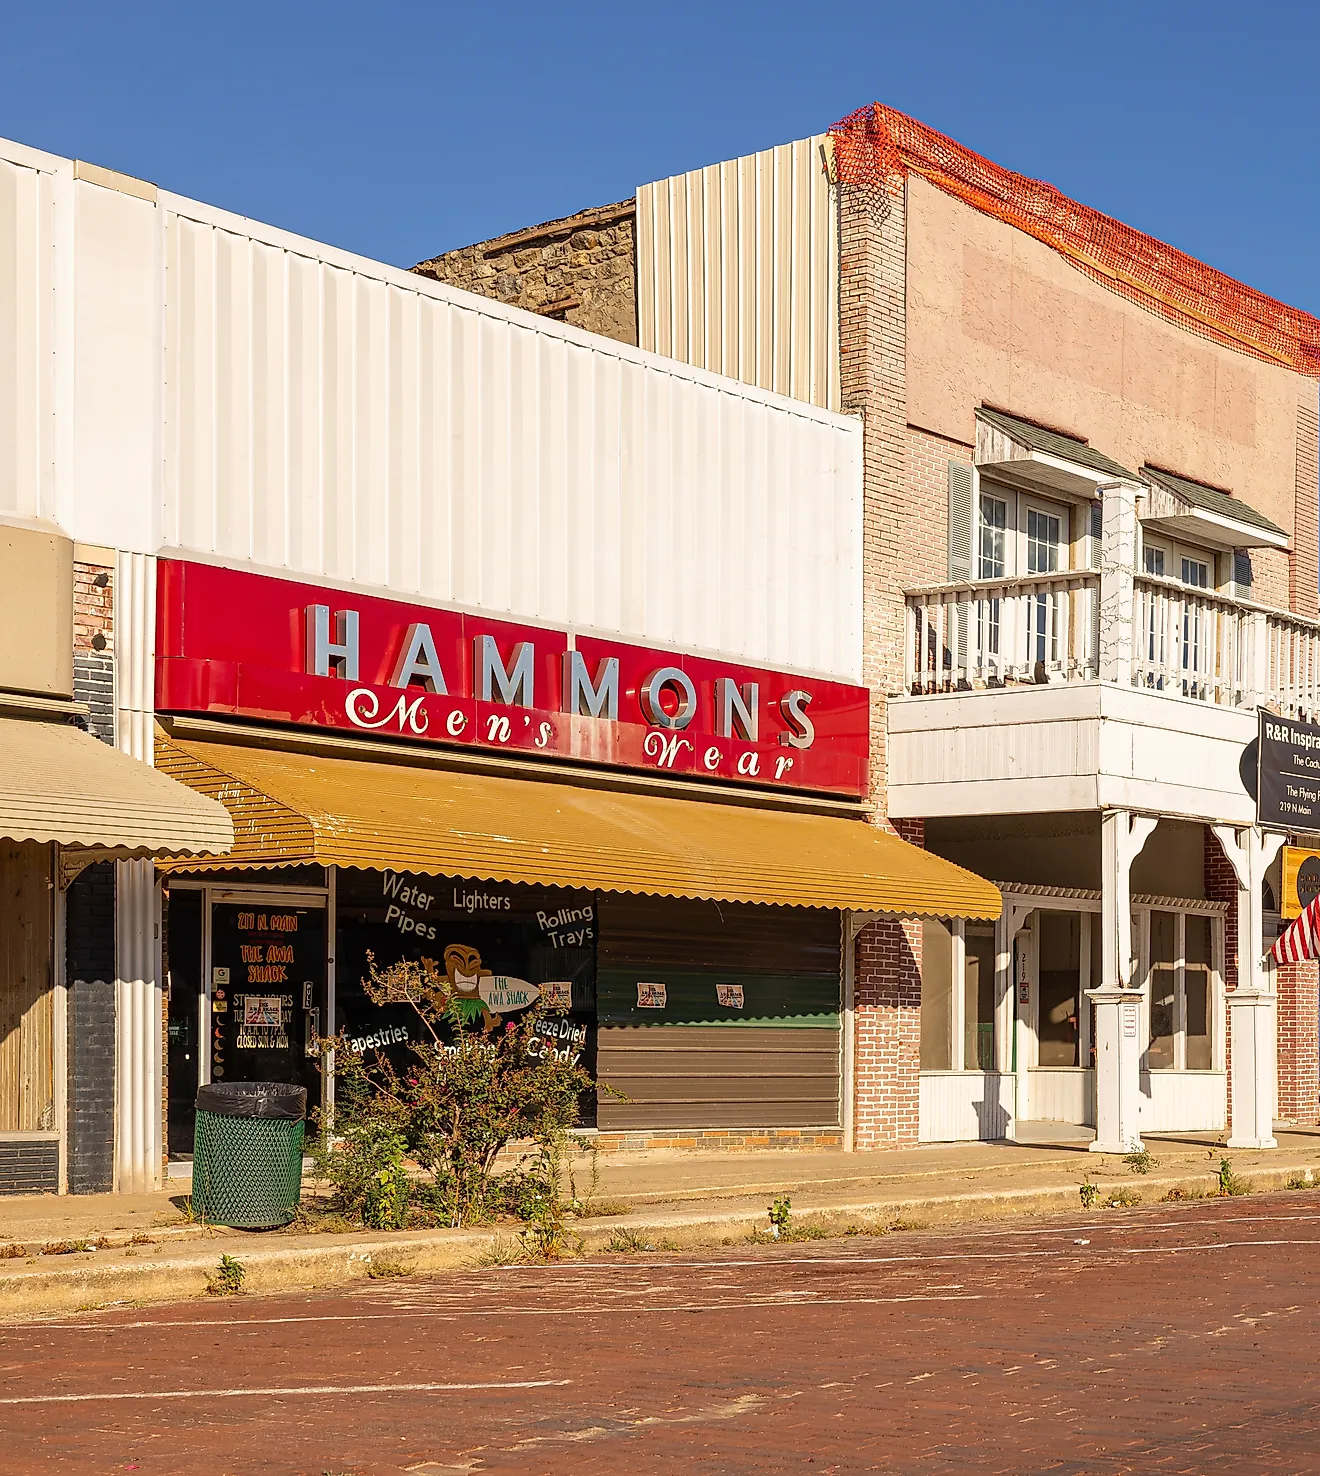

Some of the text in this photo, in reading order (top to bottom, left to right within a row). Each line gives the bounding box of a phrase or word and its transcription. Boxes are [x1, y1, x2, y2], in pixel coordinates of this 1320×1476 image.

[304, 603, 816, 750] HAMMONS
[344, 688, 795, 780] Men's Wear
[1265, 722, 1290, 744] R&R
[1293, 754, 1304, 767] The
[1286, 784, 1298, 797] The
[1299, 786, 1317, 803] Flying
[1279, 801, 1291, 812] 219
[1291, 803, 1298, 813] N
[1297, 804, 1312, 815] Main
[382, 870, 436, 911] Water
[453, 887, 511, 914] Lighters
[237, 912, 255, 930] 217
[270, 914, 298, 932] MAIN
[384, 904, 437, 941] Pipes
[536, 905, 594, 931] Rolling
[547, 927, 594, 949] Trays
[240, 944, 295, 963] THE AWA
[247, 965, 289, 984] SHACK
[494, 976, 508, 990] THE
[488, 991, 504, 1006] AWA
[506, 990, 530, 1005] SHACK
